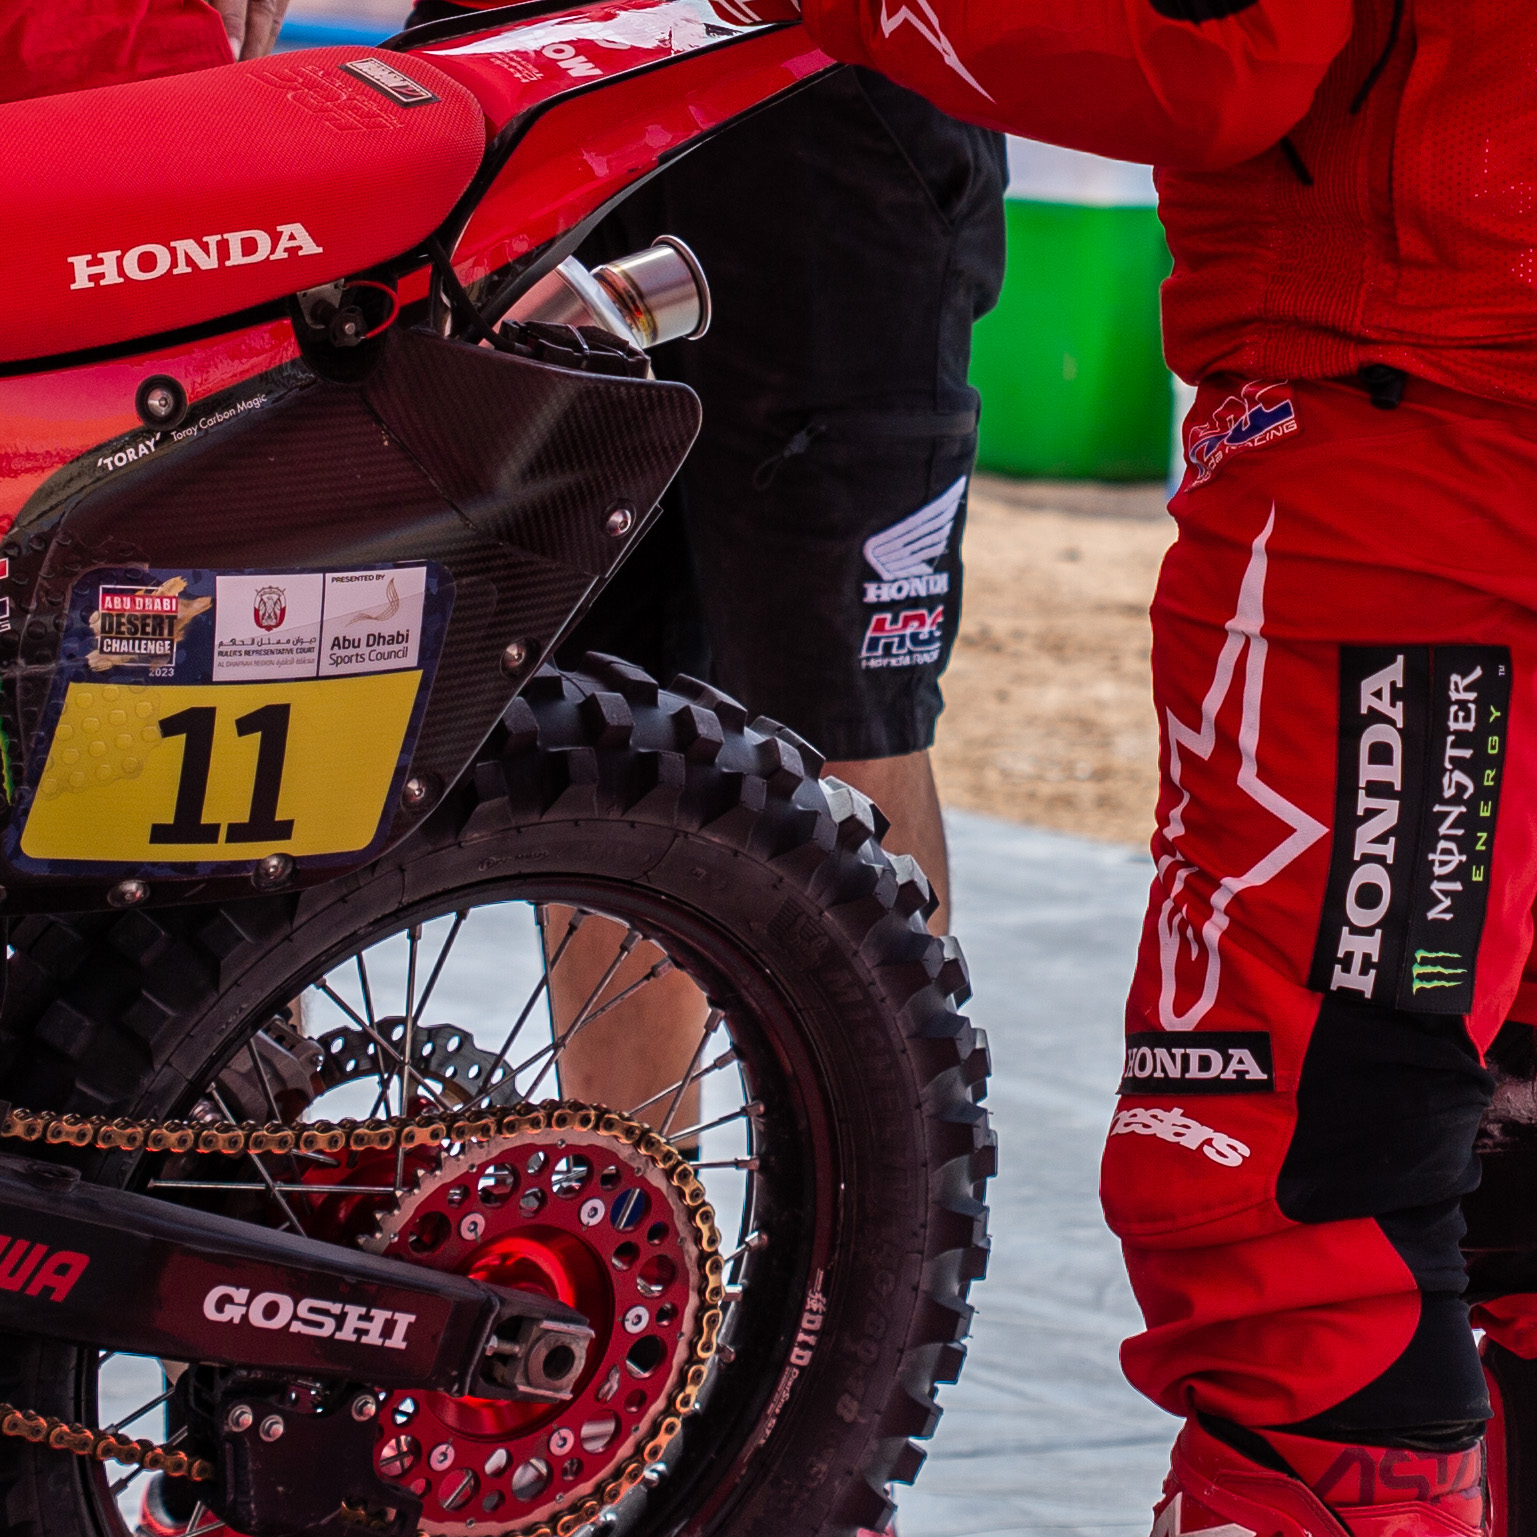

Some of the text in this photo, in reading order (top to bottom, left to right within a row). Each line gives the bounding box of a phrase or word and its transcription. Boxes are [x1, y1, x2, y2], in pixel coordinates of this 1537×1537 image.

[68, 222, 324, 291] HONDA
[170, 424, 198, 443] Toray
[199, 407, 237, 431] Carbon
[236, 393, 269, 415] Magic
[331, 574, 386, 584] PRESENTED BY
[103, 595, 177, 612] ABU DHABI
[100, 612, 177, 638] DESERT
[330, 628, 410, 652] Abu Dhabi
[102, 638, 172, 655] CHALLENGE
[217, 645, 316, 658] RULER'S REPRESENTATIVE COURT
[329, 645, 409, 668] Sports Council
[148, 666, 175, 678] 2023
[148, 703, 295, 846] 11
[1425, 665, 1484, 921] MONSTER
[1470, 703, 1502, 882] ENERGY
[1329, 653, 1405, 1000] HONDA
[1124, 1046, 1269, 1080] HONDA
[202, 1283, 417, 1351] GOSHI
